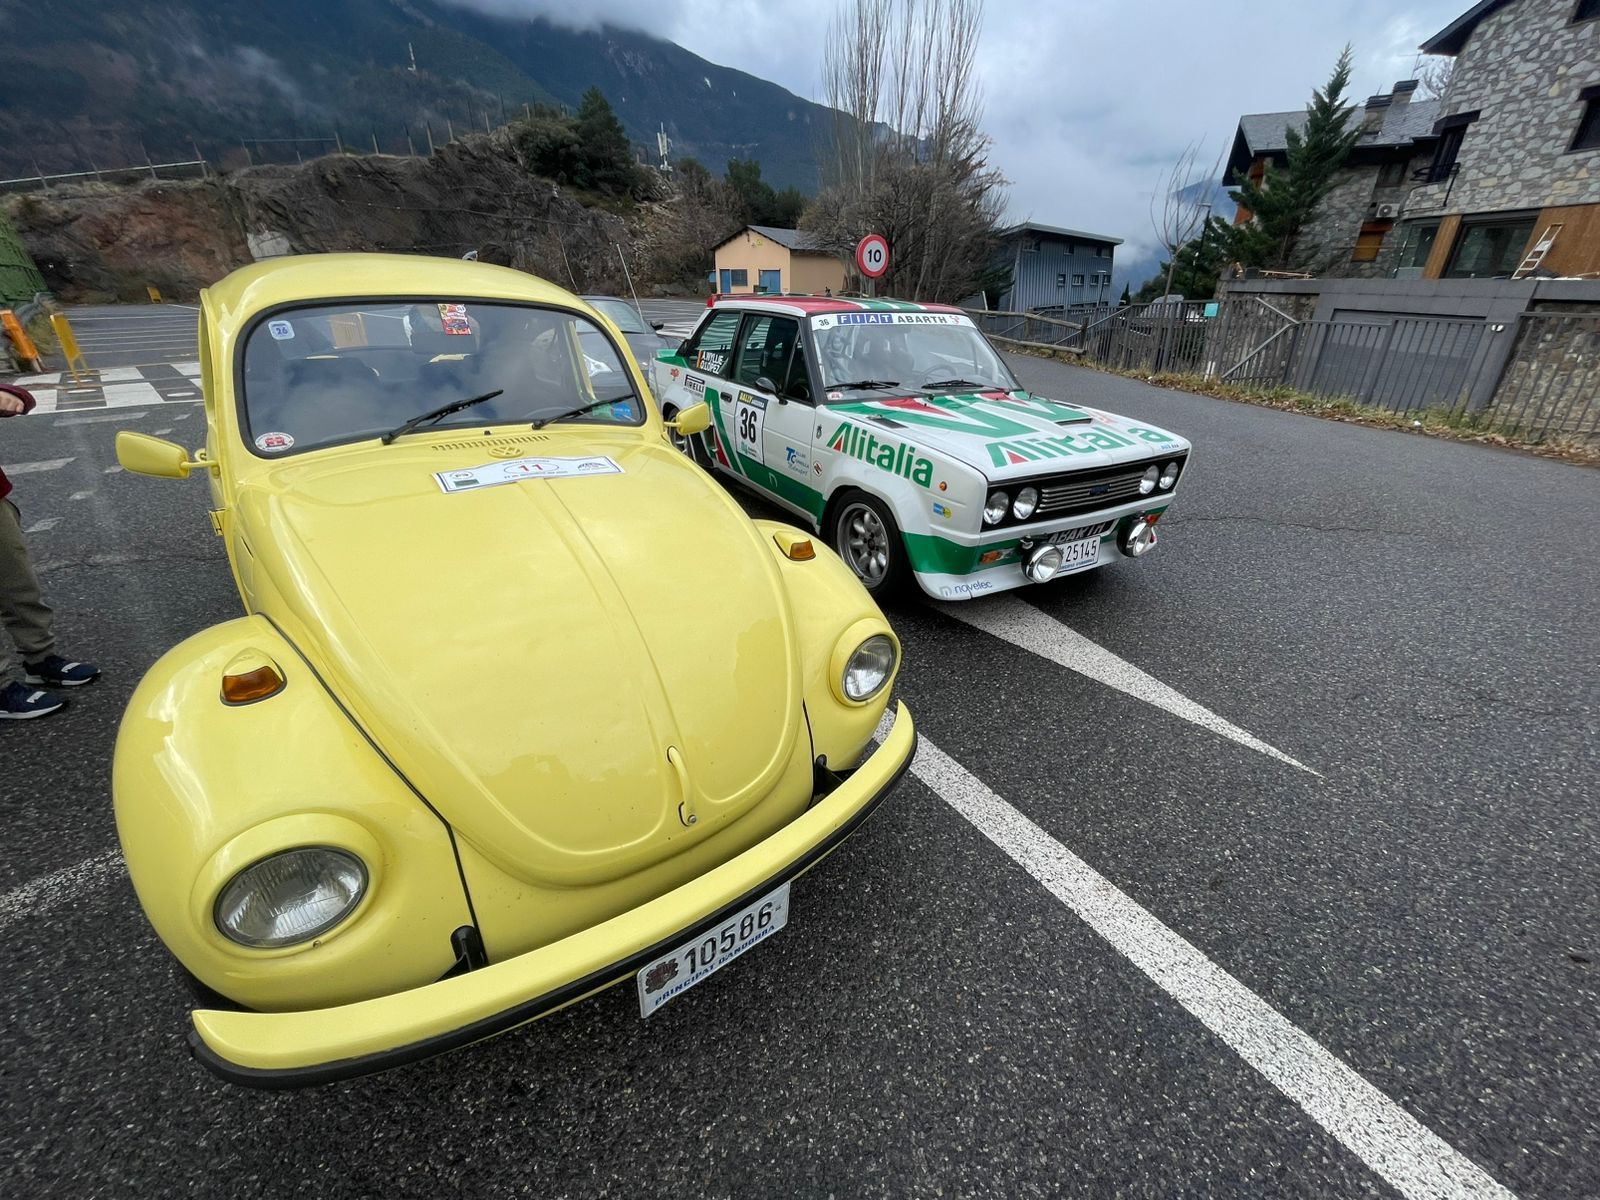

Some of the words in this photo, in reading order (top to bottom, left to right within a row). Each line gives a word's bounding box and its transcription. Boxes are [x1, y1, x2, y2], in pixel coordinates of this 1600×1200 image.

[868, 249, 881, 262] 10
[819, 319, 829, 327] 36
[838, 314, 893, 325] FIAT
[897, 315, 948, 324] ABARTH
[740, 407, 757, 444] 36
[826, 421, 934, 489] Alitalia
[985, 426, 1175, 468] Alitala
[1066, 540, 1096, 562] 25145
[954, 580, 992, 594] novelec
[684, 901, 773, 975] 10586
